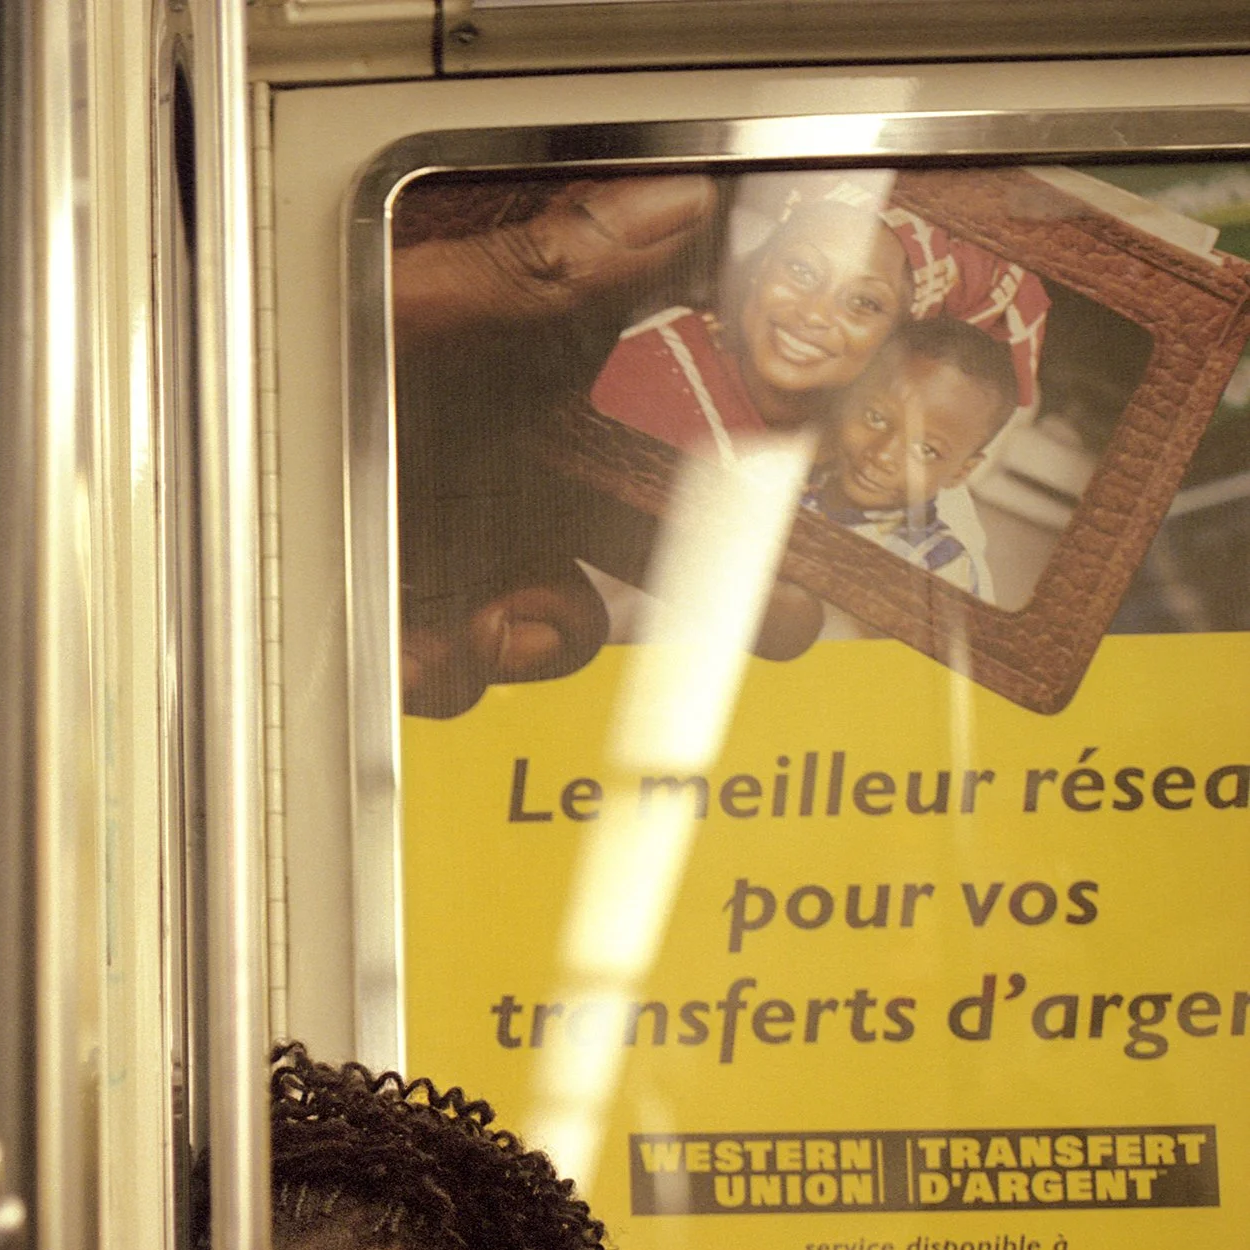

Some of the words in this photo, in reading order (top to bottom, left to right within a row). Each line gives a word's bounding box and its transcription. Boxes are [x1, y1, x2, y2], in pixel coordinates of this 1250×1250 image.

[507, 757, 604, 823] Le
[637, 751, 996, 821] meilleur
[720, 876, 934, 954] pour
[960, 880, 1099, 928] vos
[639, 1138, 873, 1173] WESTERN
[918, 1133, 1207, 1169] TRANSFERT
[714, 1173, 874, 1207] UNION
[918, 1169, 1158, 1204] D'ARGENT
